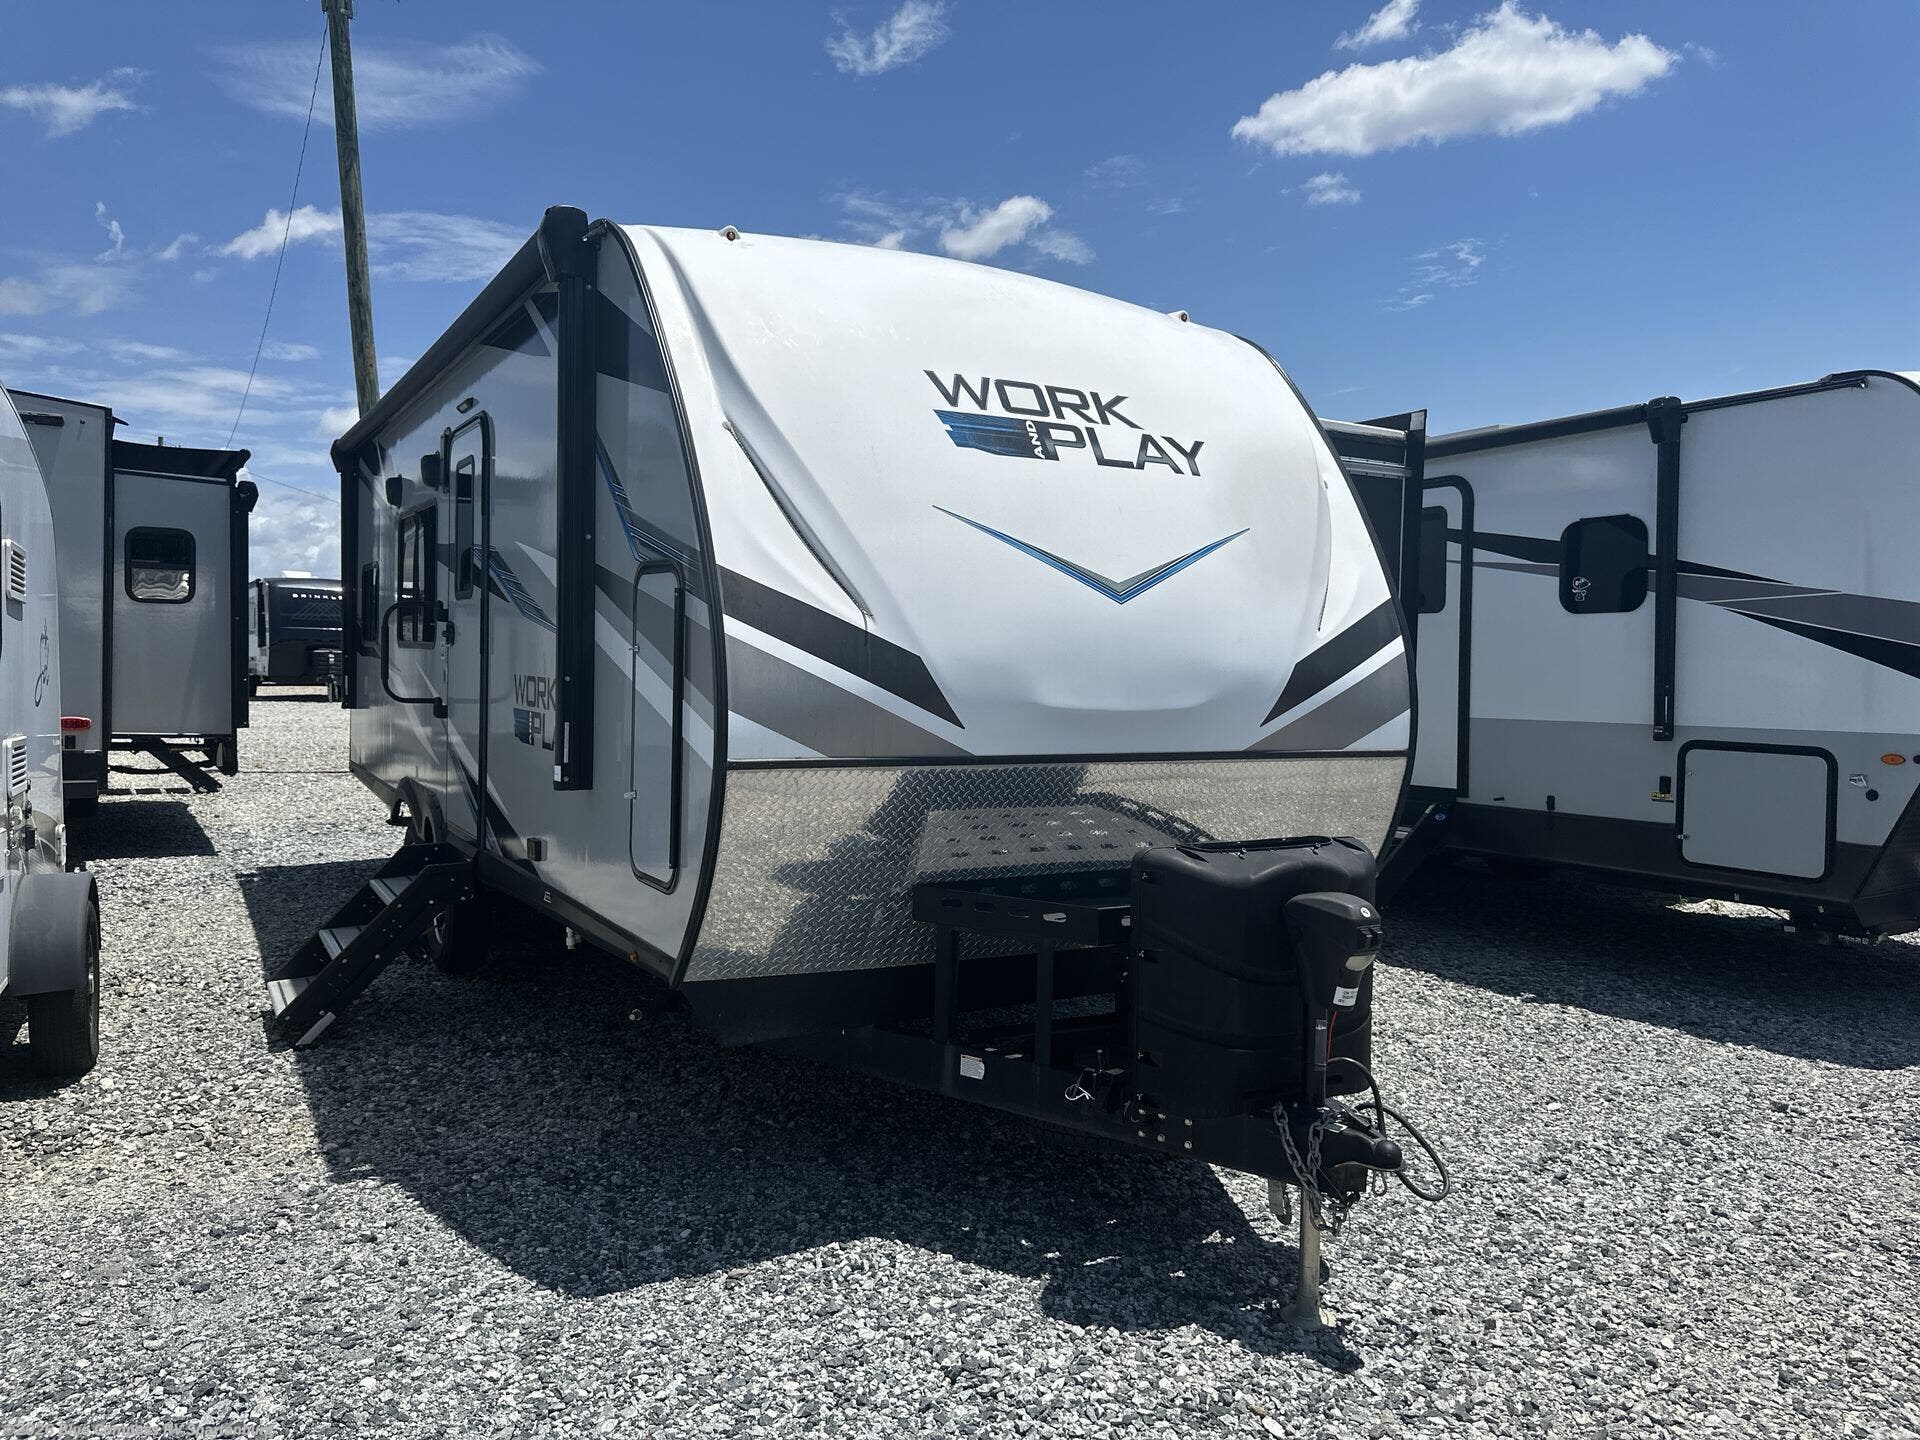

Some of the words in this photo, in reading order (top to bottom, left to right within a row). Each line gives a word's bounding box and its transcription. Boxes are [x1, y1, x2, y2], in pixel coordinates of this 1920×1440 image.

[923, 369, 1145, 430] WORK
[1025, 419, 1046, 460] AND
[1037, 420, 1205, 477] PLAY
[514, 673, 558, 712] WORK
[530, 711, 556, 751] PL
